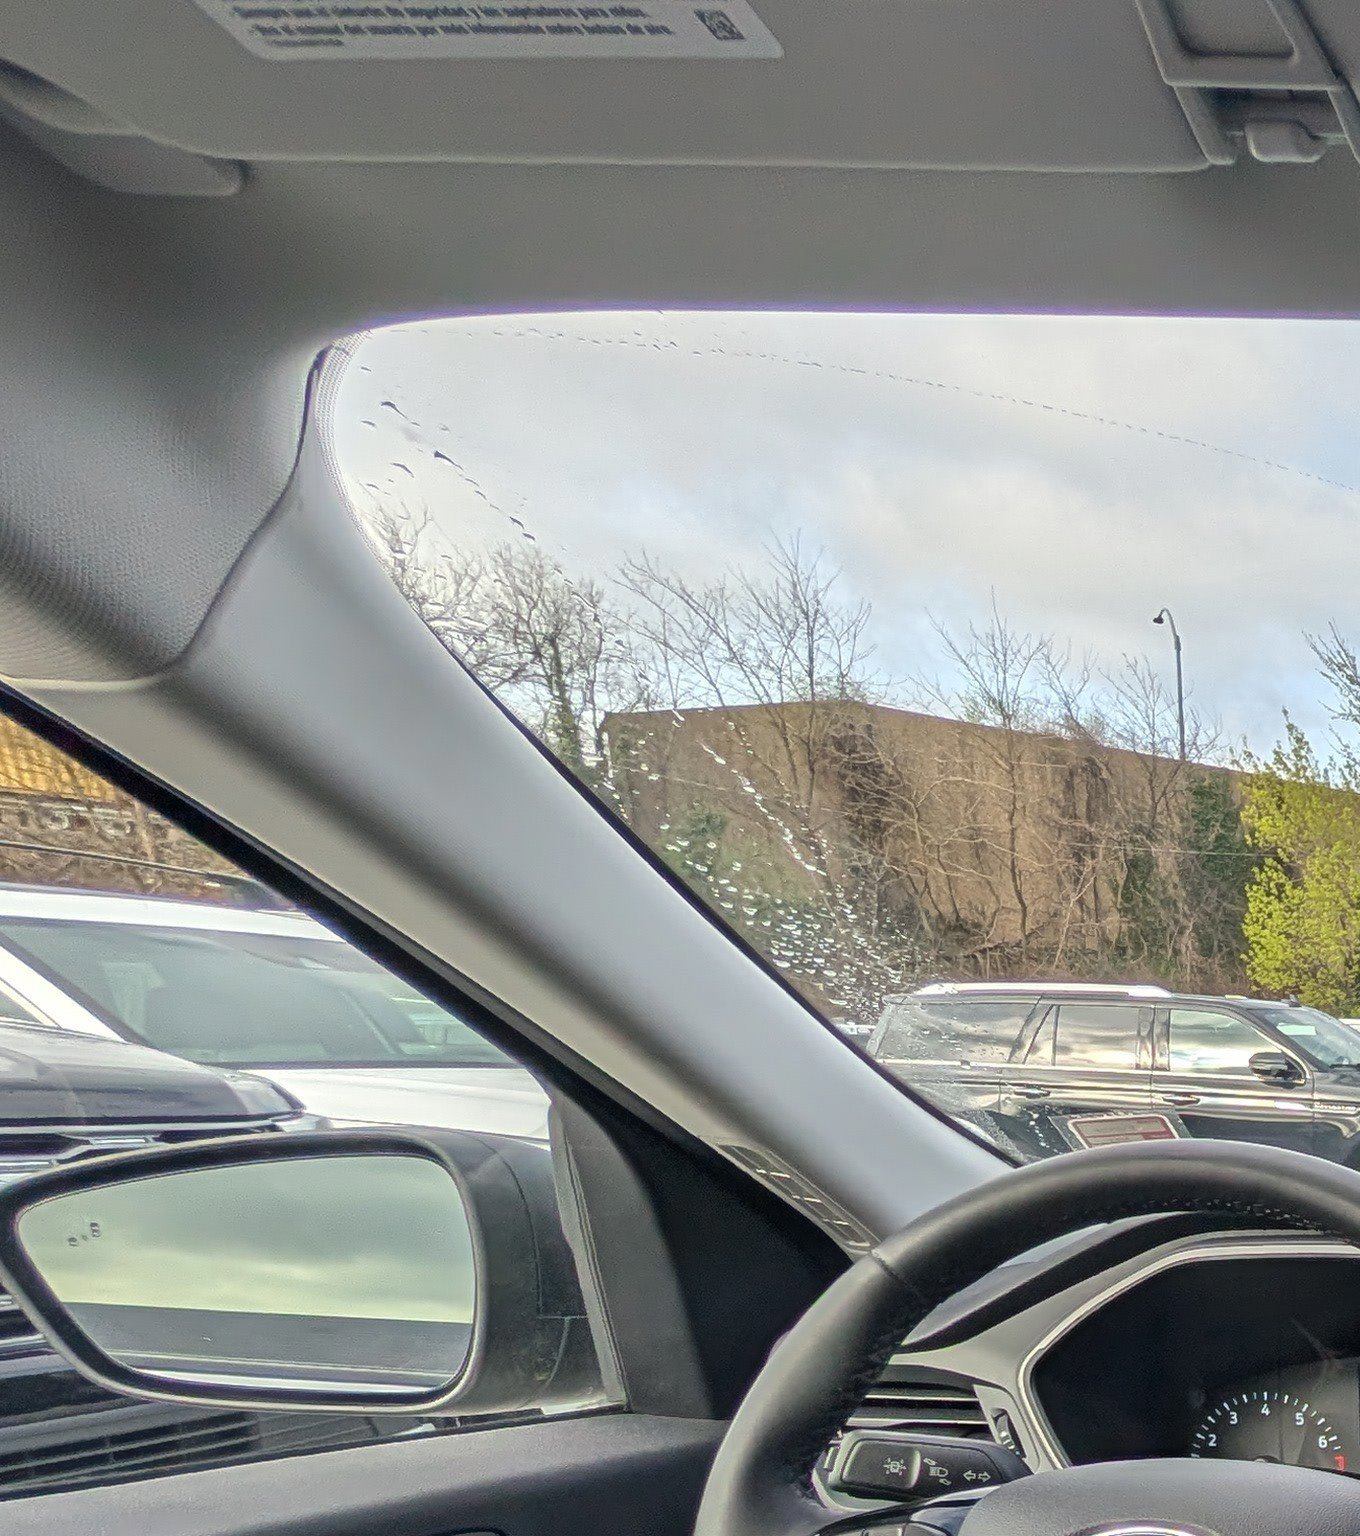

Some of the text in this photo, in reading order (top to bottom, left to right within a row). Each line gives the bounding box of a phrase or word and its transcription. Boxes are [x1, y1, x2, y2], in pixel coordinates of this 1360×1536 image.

[1261, 1403, 1271, 1416] 4
[1229, 1411, 1238, 1425] 3
[1295, 1412, 1305, 1426] 5
[1208, 1434, 1217, 1447] 2
[1318, 1435, 1328, 1449] 6
